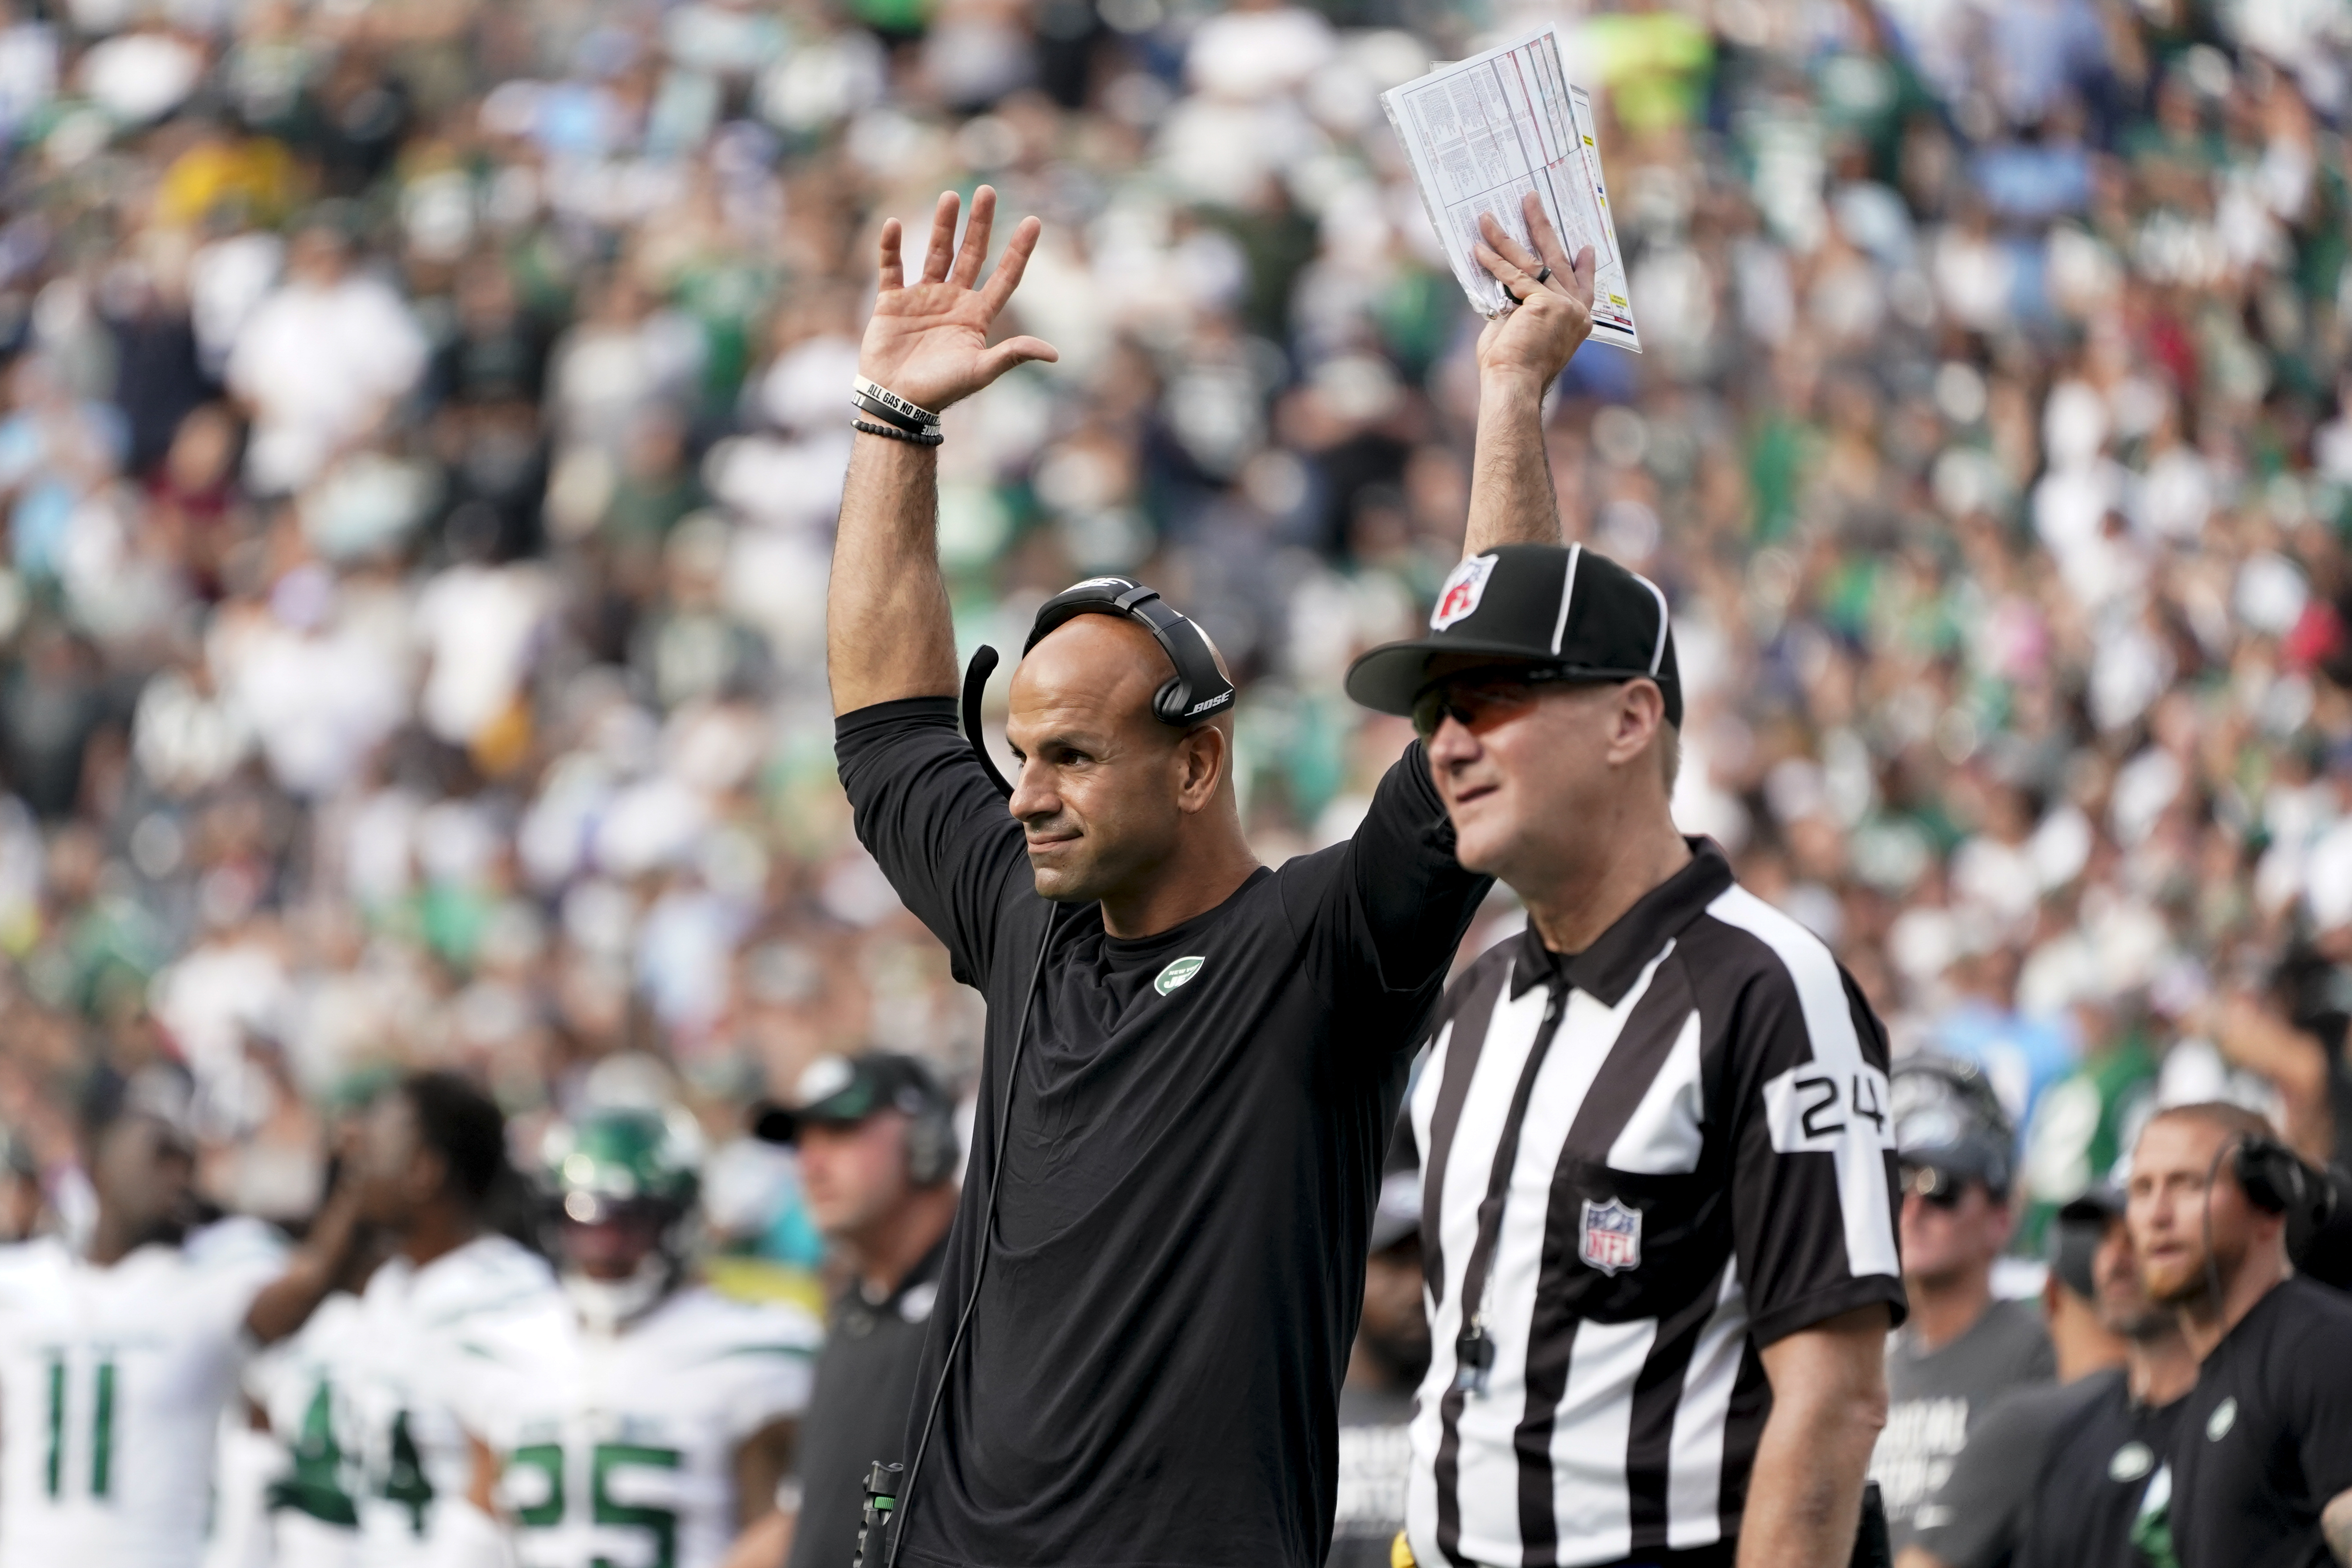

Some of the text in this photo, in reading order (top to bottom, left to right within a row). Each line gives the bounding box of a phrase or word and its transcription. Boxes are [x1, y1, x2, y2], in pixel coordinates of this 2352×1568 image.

[867, 384, 882, 399] ALL
[883, 393, 900, 408] GAS
[900, 402, 913, 415] NO
[1184, 689, 1233, 717] BOSE
[1794, 1074, 1884, 1139] 24
[1586, 1228, 1635, 1265] NFL
